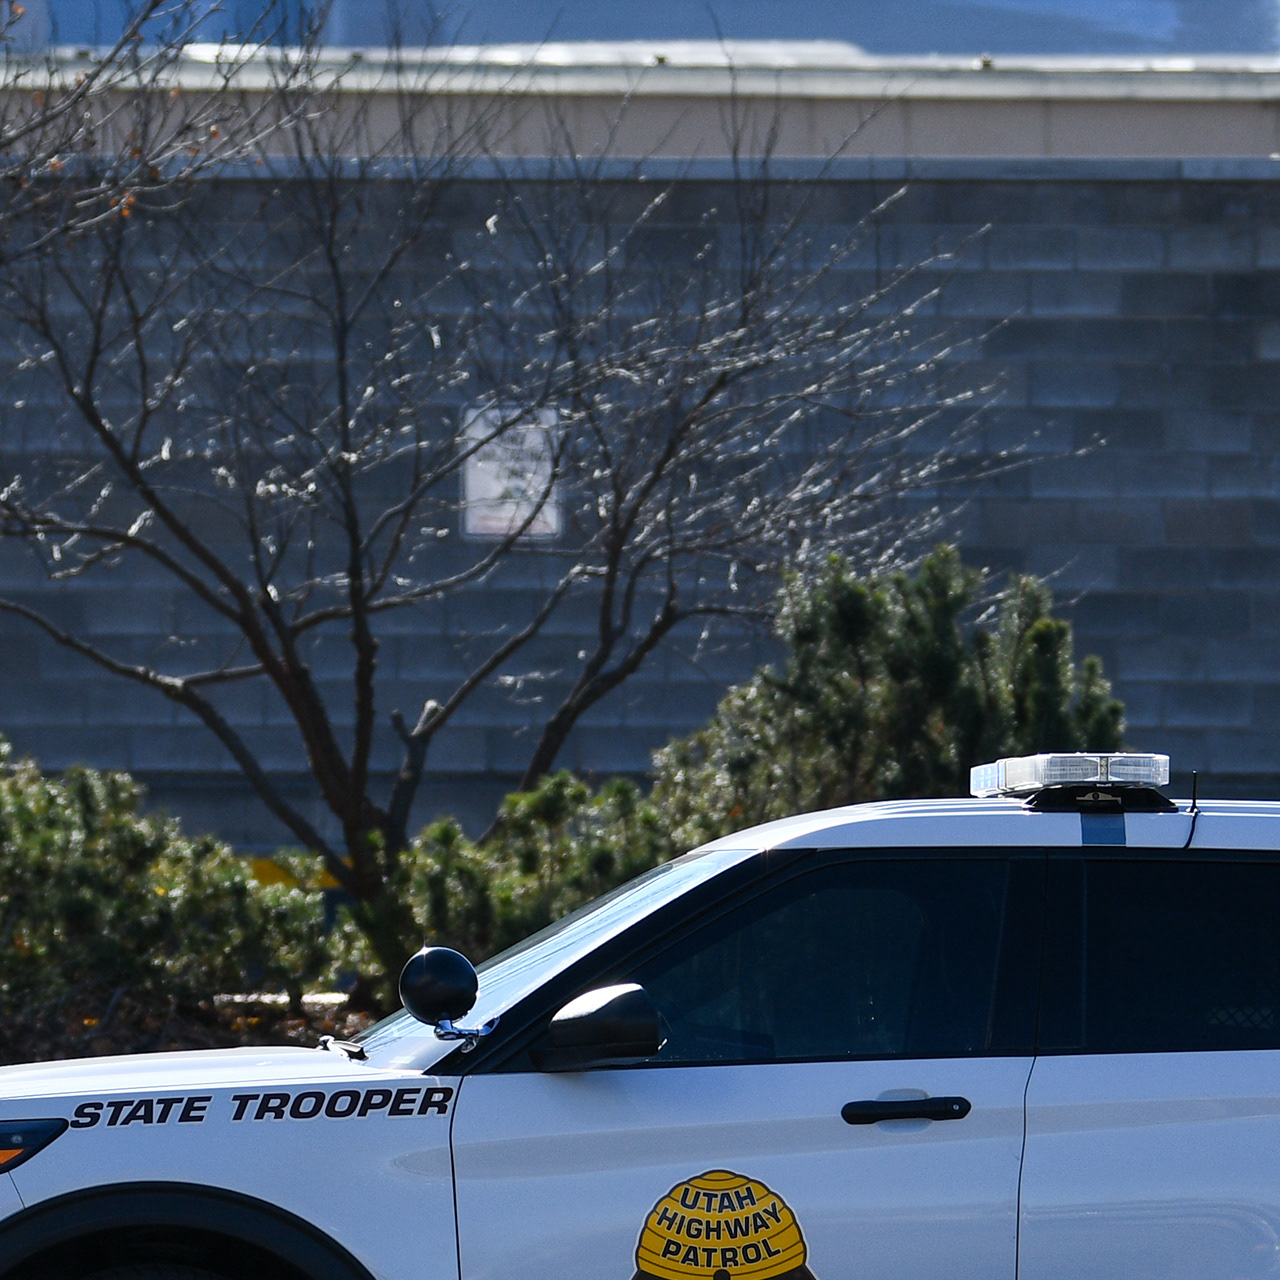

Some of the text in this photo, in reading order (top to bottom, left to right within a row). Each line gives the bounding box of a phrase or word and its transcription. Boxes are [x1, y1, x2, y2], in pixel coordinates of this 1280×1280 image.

[70, 1087, 454, 1128] STATE TROOPER
[680, 1186, 757, 1214] UTAH
[656, 1202, 782, 1240] HIGHWAY
[661, 1238, 781, 1268] PATROL
